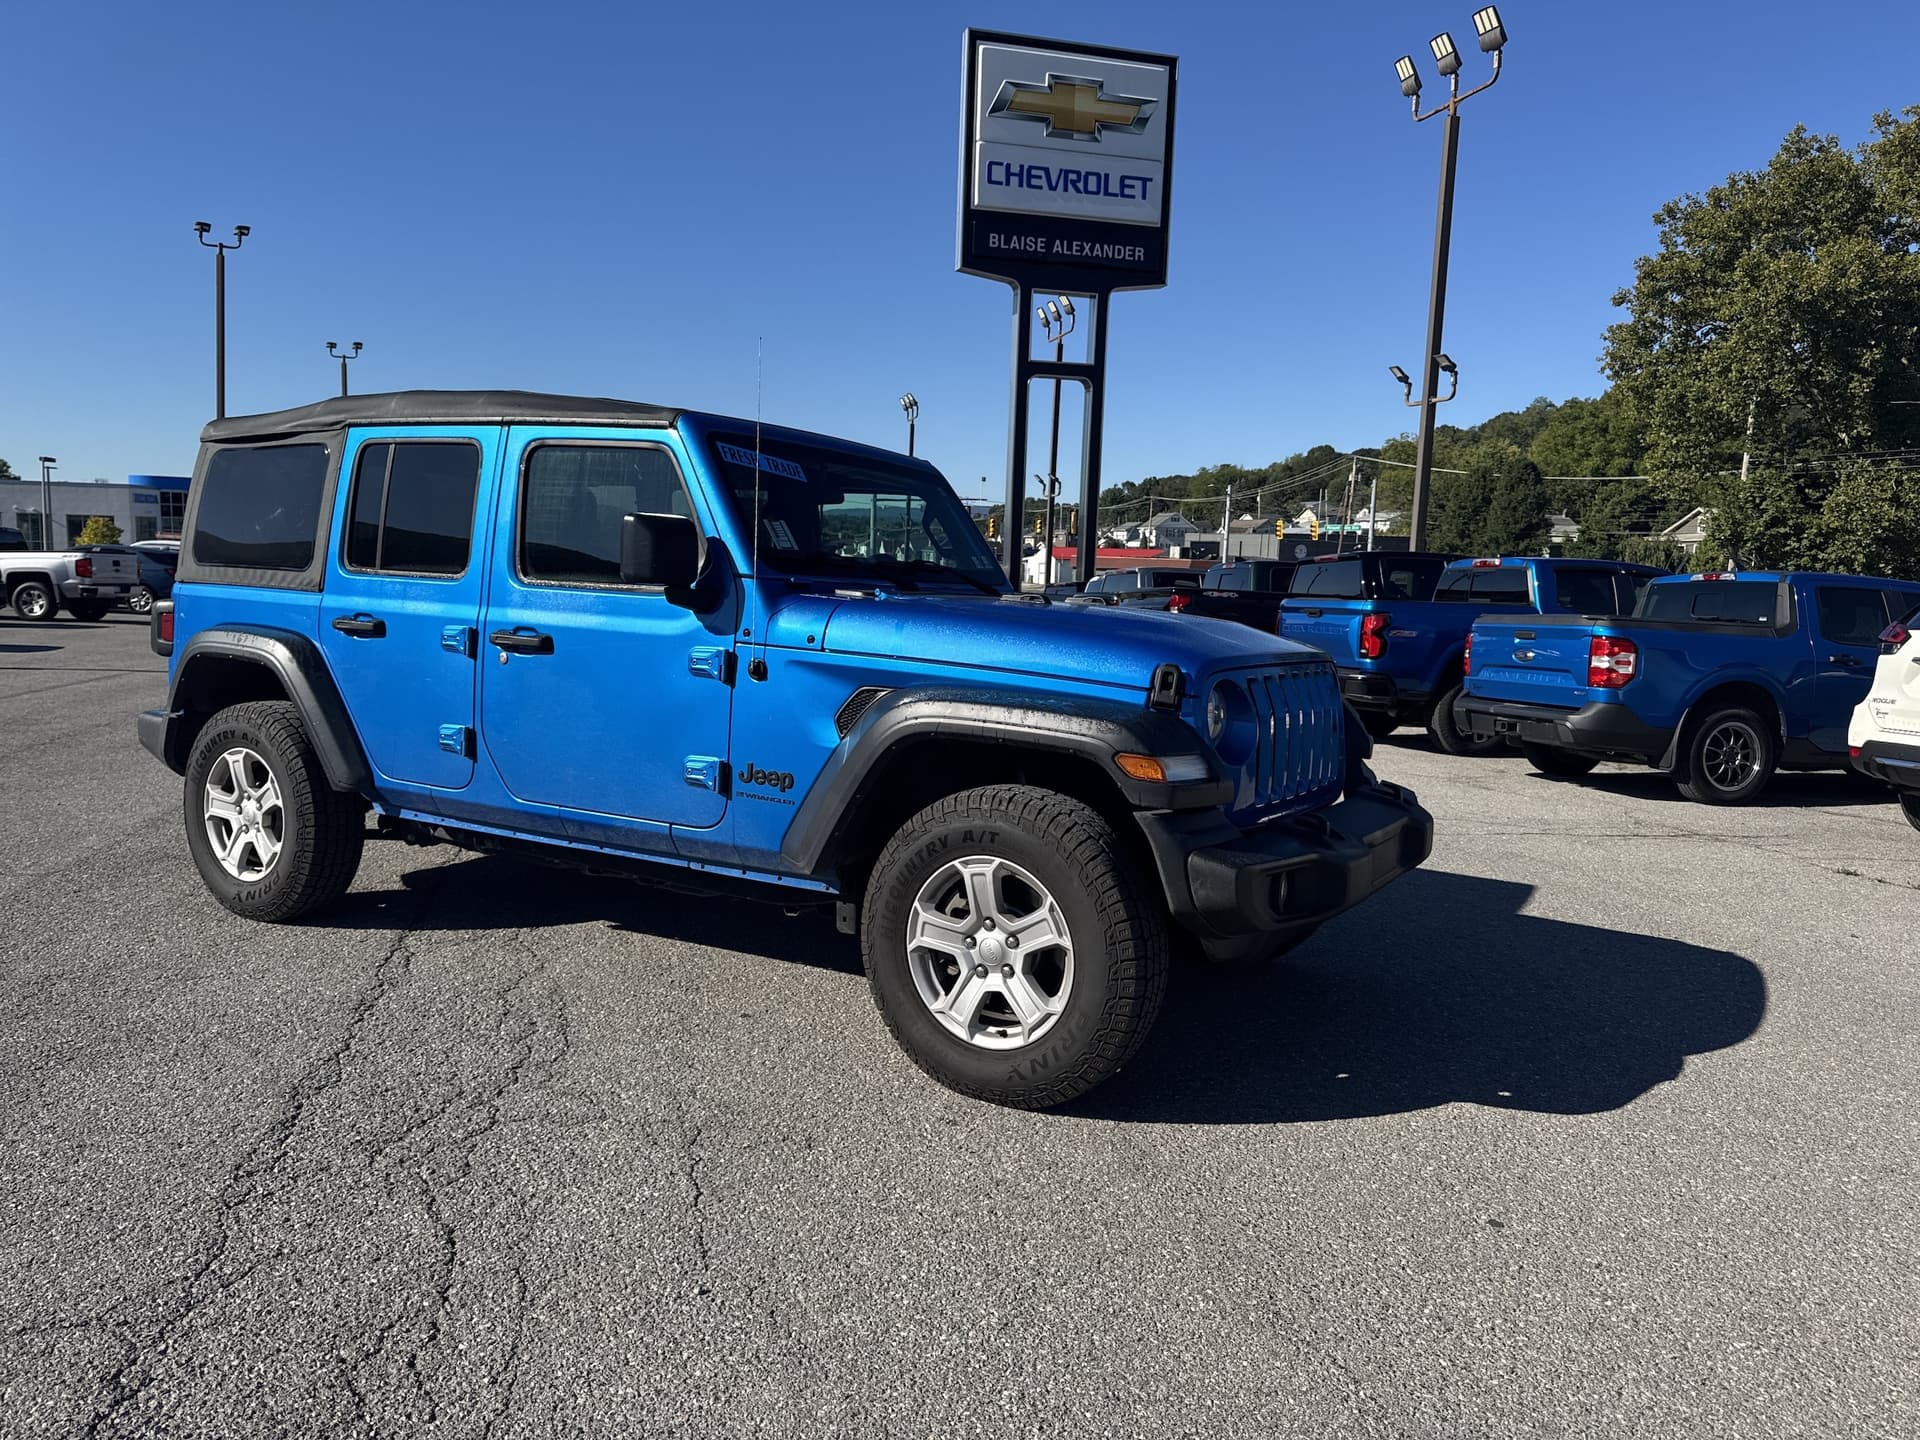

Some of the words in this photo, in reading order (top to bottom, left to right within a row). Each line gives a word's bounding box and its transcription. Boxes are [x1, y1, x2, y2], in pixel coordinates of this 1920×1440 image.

[987, 160, 1153, 200] CHEVROLET
[989, 233, 1047, 252] BLAISE
[1052, 239, 1145, 261] ALEXANDER
[763, 456, 803, 478] TRADE
[738, 762, 795, 792] Jeep
[962, 829, 999, 845] A/T
